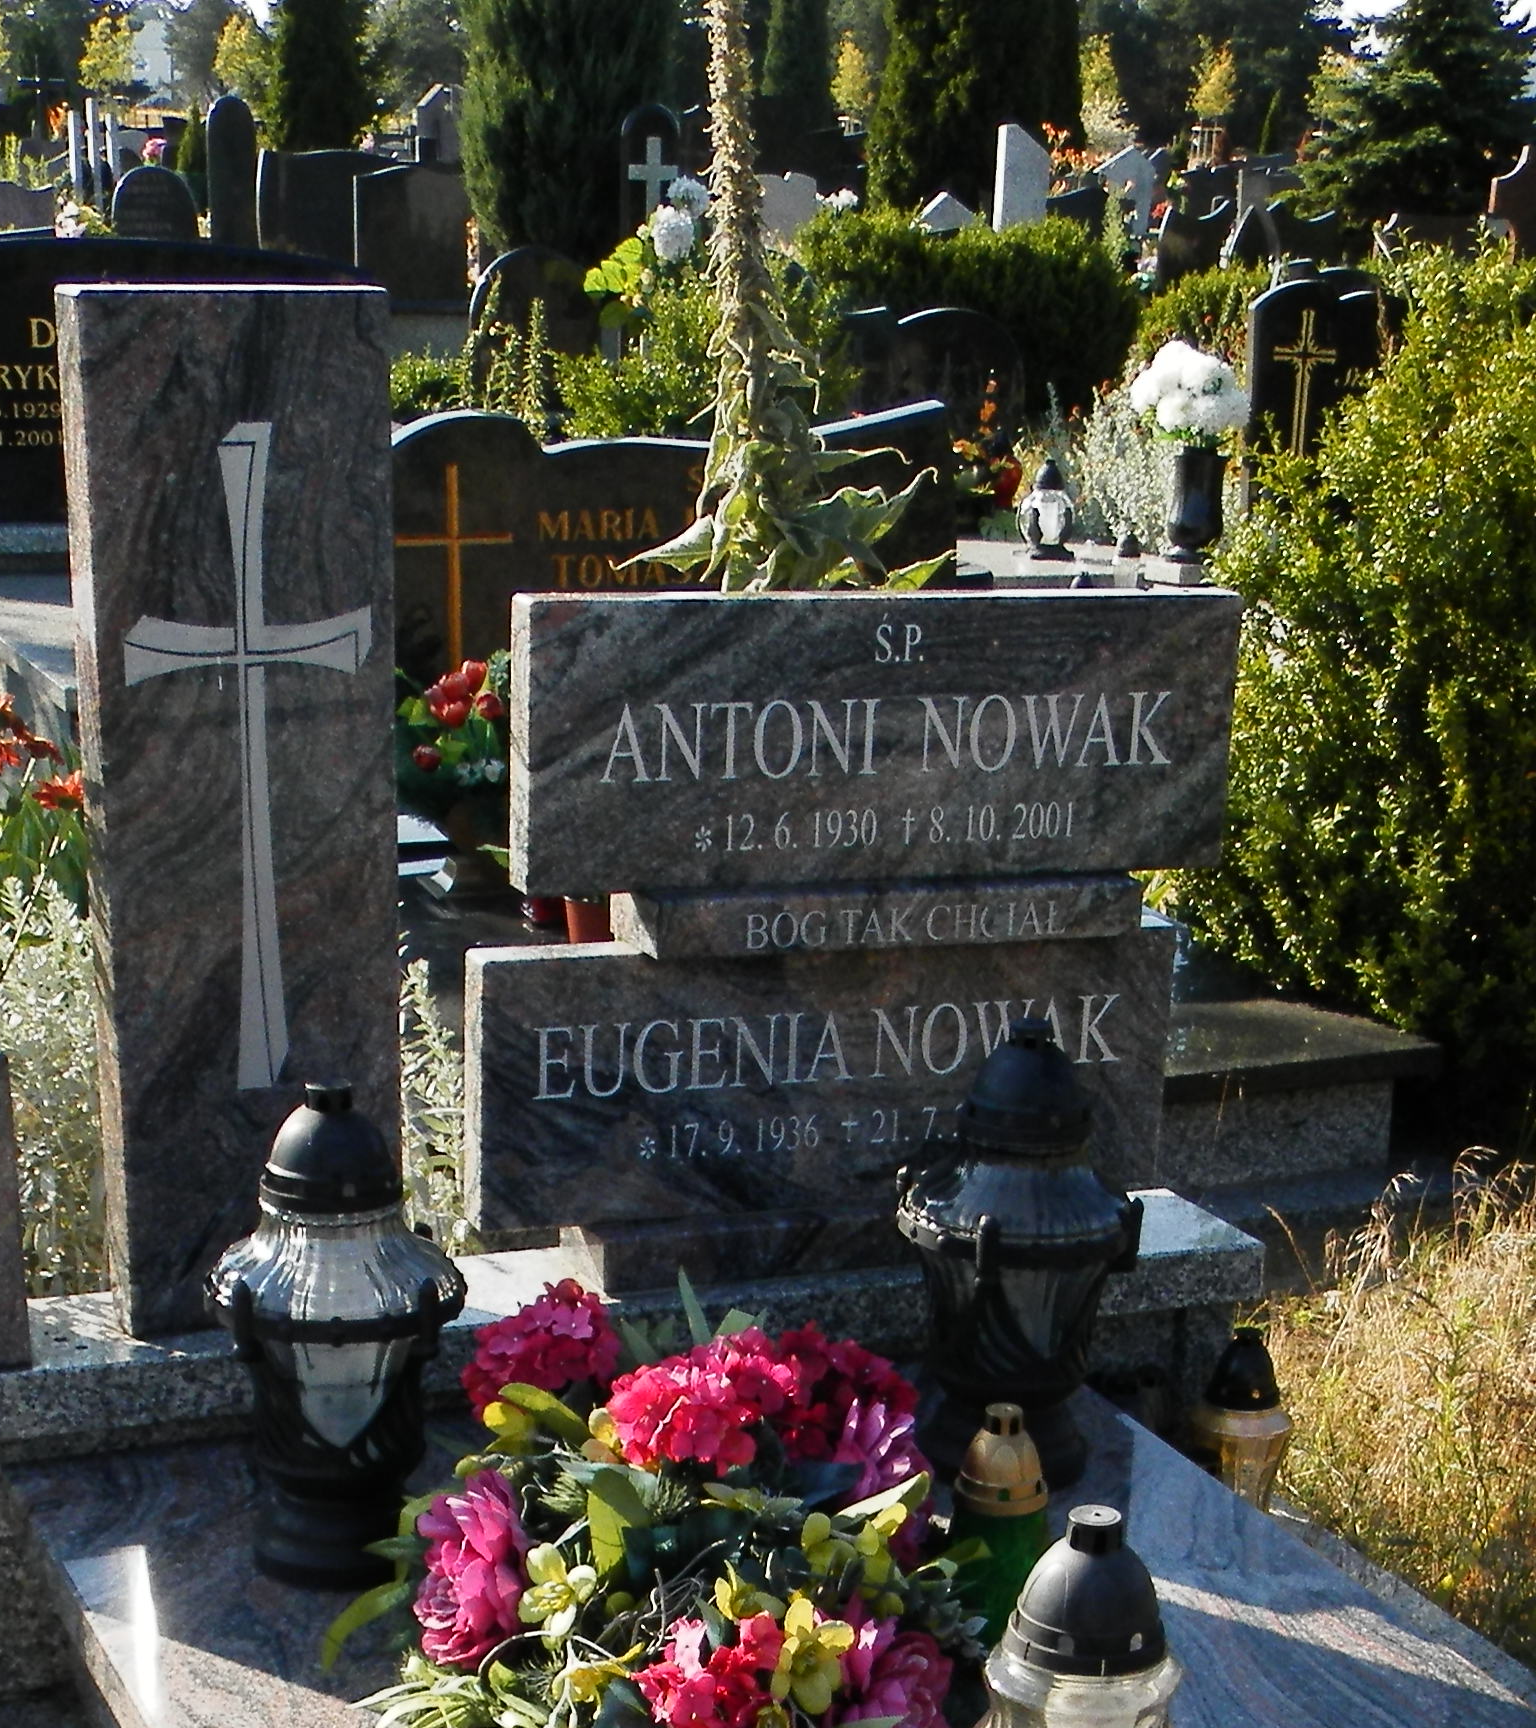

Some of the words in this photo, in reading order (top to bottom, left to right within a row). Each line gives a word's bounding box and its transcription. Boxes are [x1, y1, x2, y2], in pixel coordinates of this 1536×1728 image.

[537, 508, 660, 541] MARIA
[875, 612, 924, 663] Ś.P.
[600, 699, 881, 784] ANTONI
[916, 691, 1171, 774] NOWAK
[840, 907, 912, 945] TAK
[532, 1010, 854, 1101] EUGENIA
